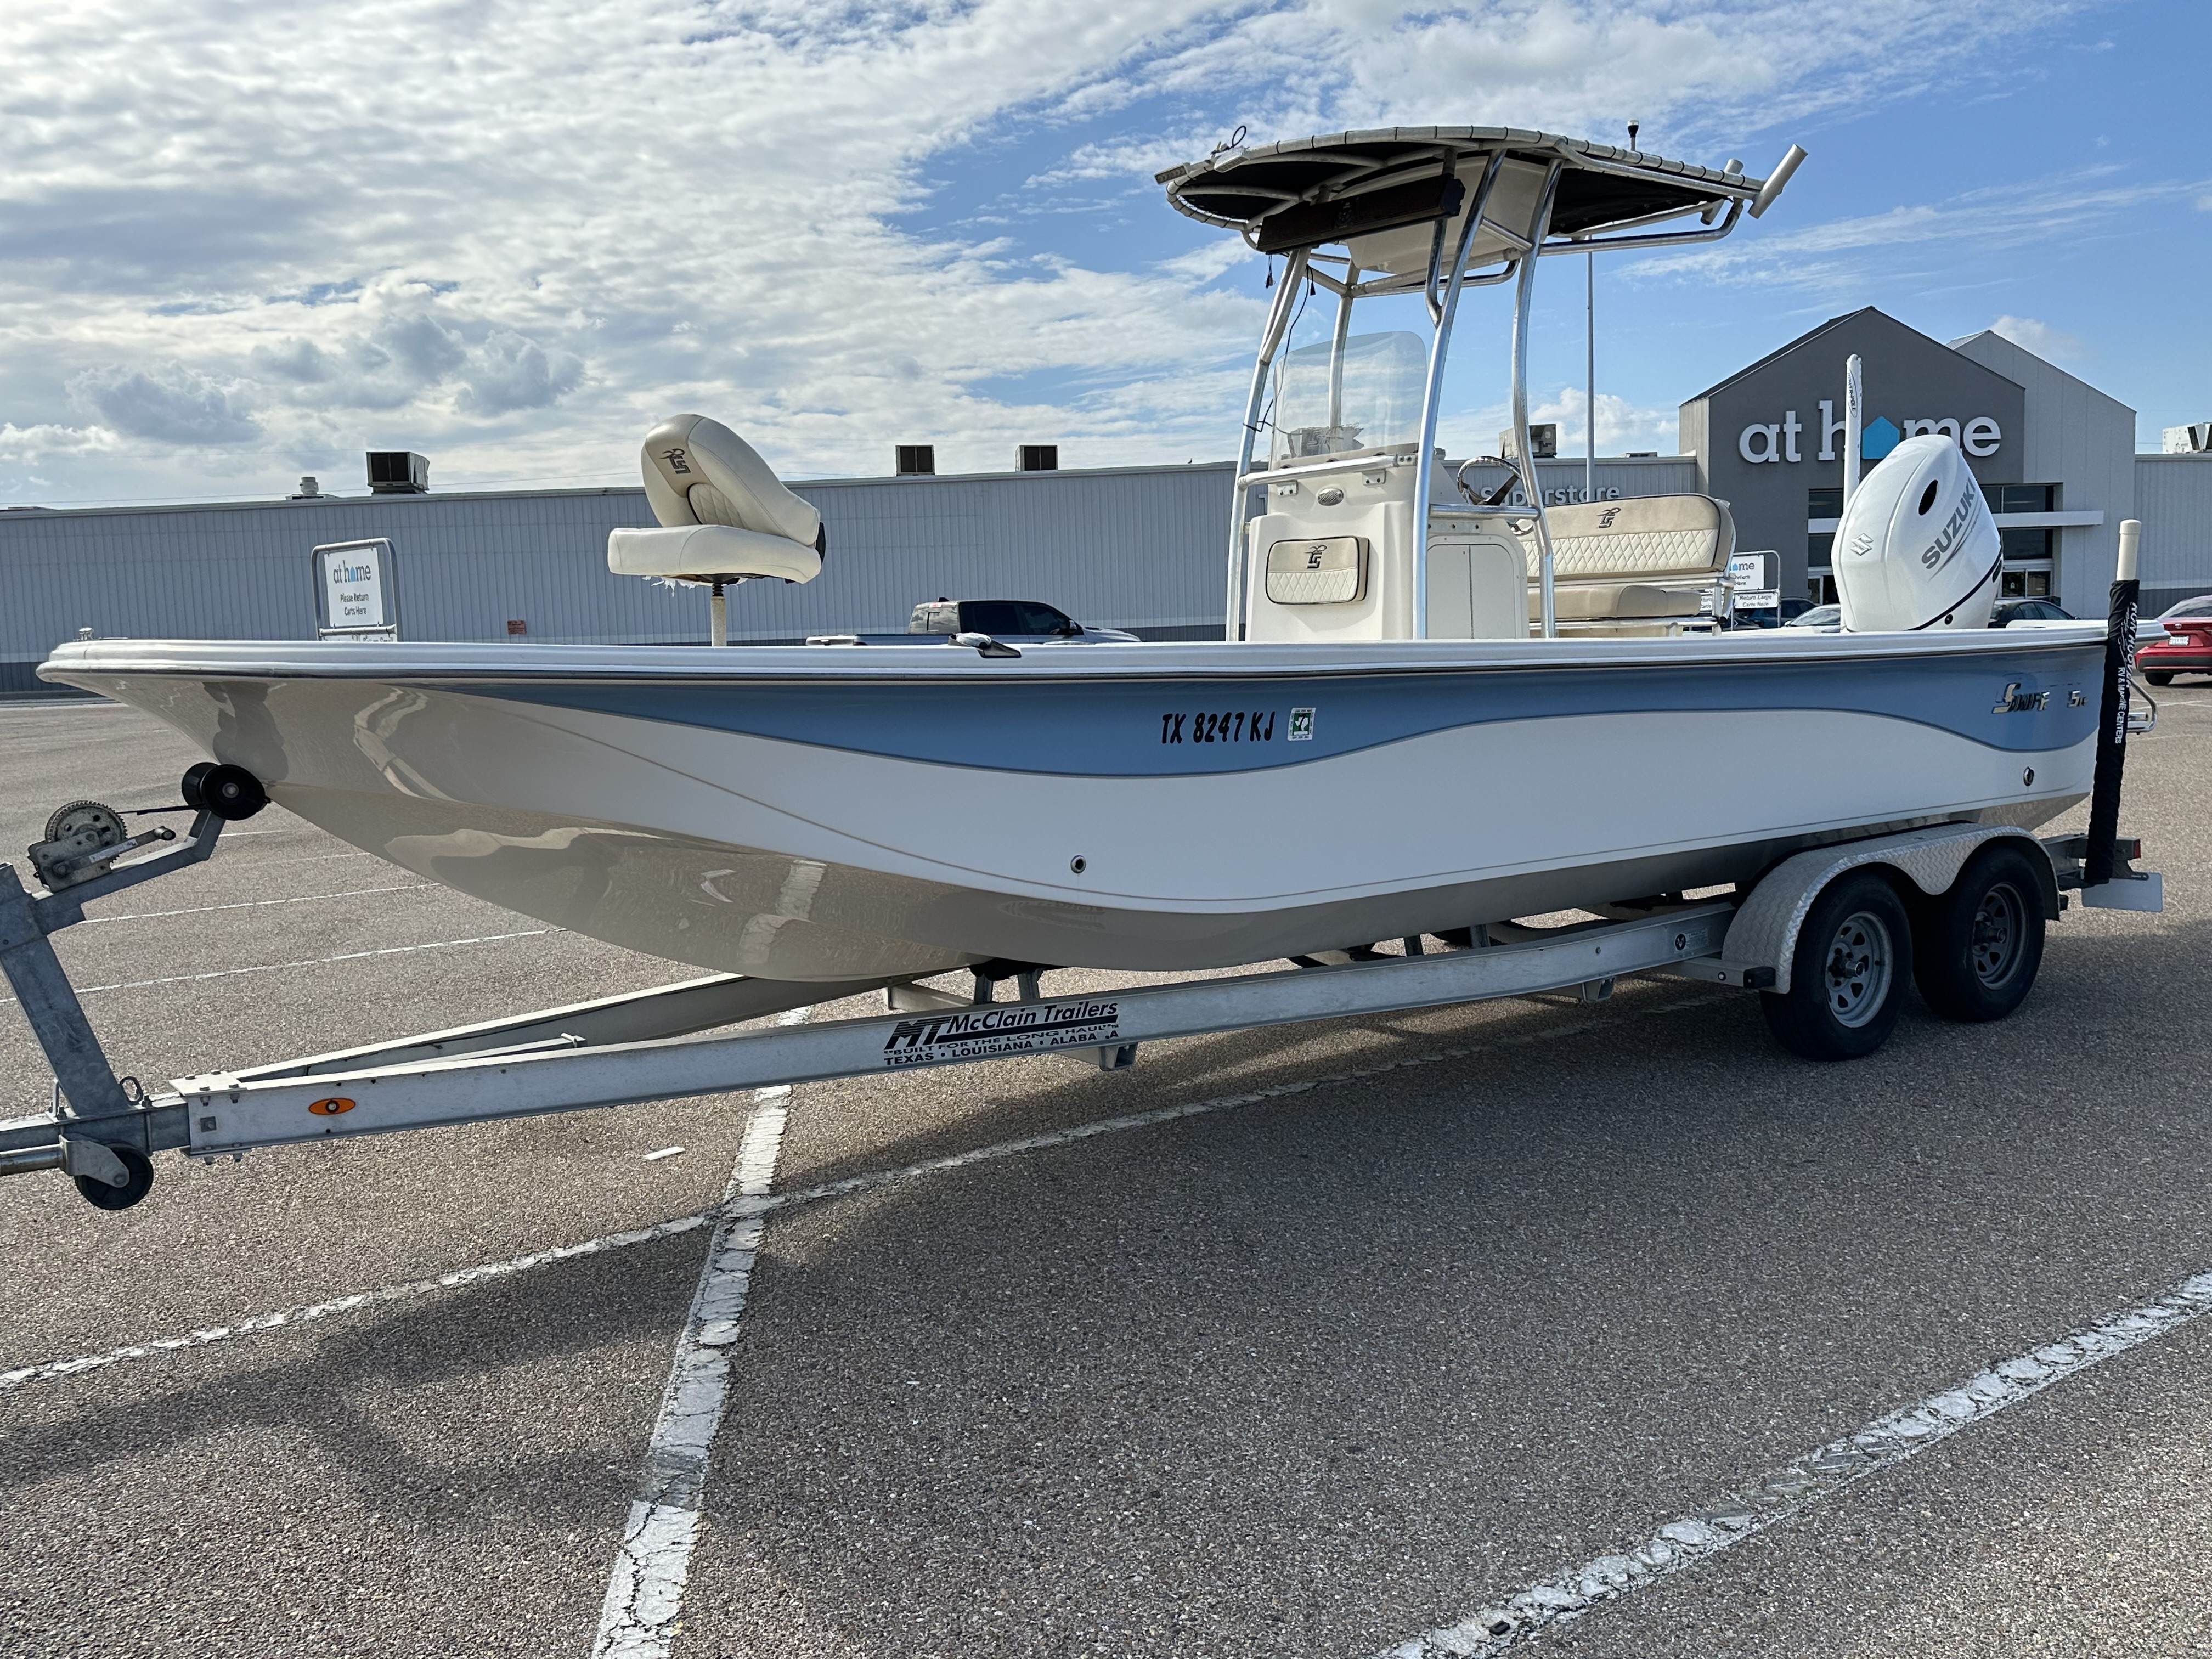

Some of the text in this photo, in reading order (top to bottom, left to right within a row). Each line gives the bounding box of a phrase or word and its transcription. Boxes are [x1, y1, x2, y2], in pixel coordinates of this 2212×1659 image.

[1738, 410, 1802, 464] at
[1921, 477, 1976, 569] SUZUKI
[333, 564, 343, 584] at
[340, 592, 369, 602] Please Return
[345, 606, 367, 616] Carts Here
[2118, 667, 2126, 677] RV
[2126, 634, 2136, 688] HOOVER
[1161, 711, 1276, 744] TX 8247 KJ
[2115, 711, 2125, 744] CENTERS
[946, 1008, 1037, 1034] McClain
[1043, 1001, 1118, 1022] Trailers
[884, 1030, 1119, 1065] TEXAS LOUISIANA ALABAA
[1007, 1031, 1059, 1041] LONG
